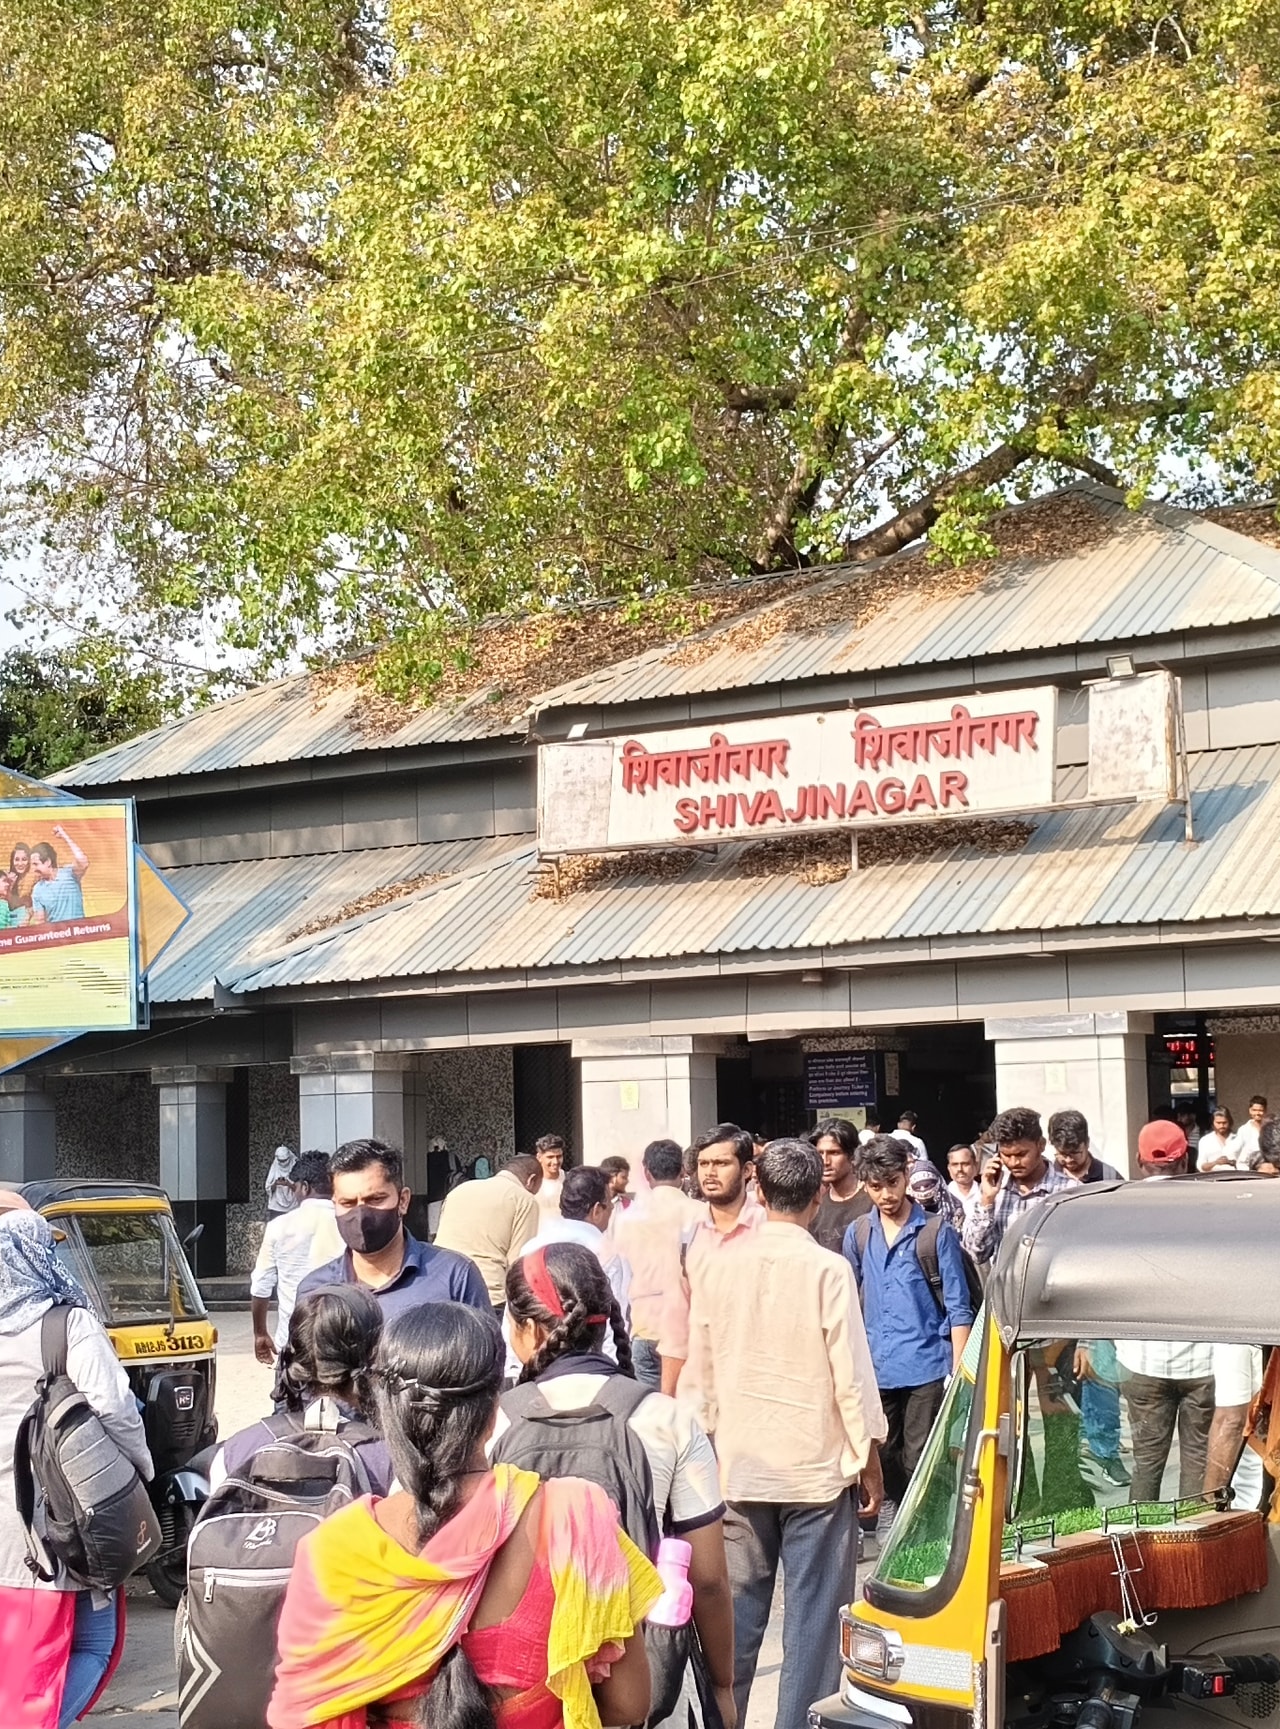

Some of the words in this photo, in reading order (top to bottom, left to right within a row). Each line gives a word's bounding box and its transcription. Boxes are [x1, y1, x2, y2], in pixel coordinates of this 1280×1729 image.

[619, 732, 791, 797] शिवाजीनगर
[850, 704, 1040, 773] शिवाजीनगर
[674, 770, 969, 833] SHIVAJINAGAR
[14, 927, 72, 945] Guaranteed
[73, 921, 111, 937] Returns
[166, 1335, 205, 1351] 3113
